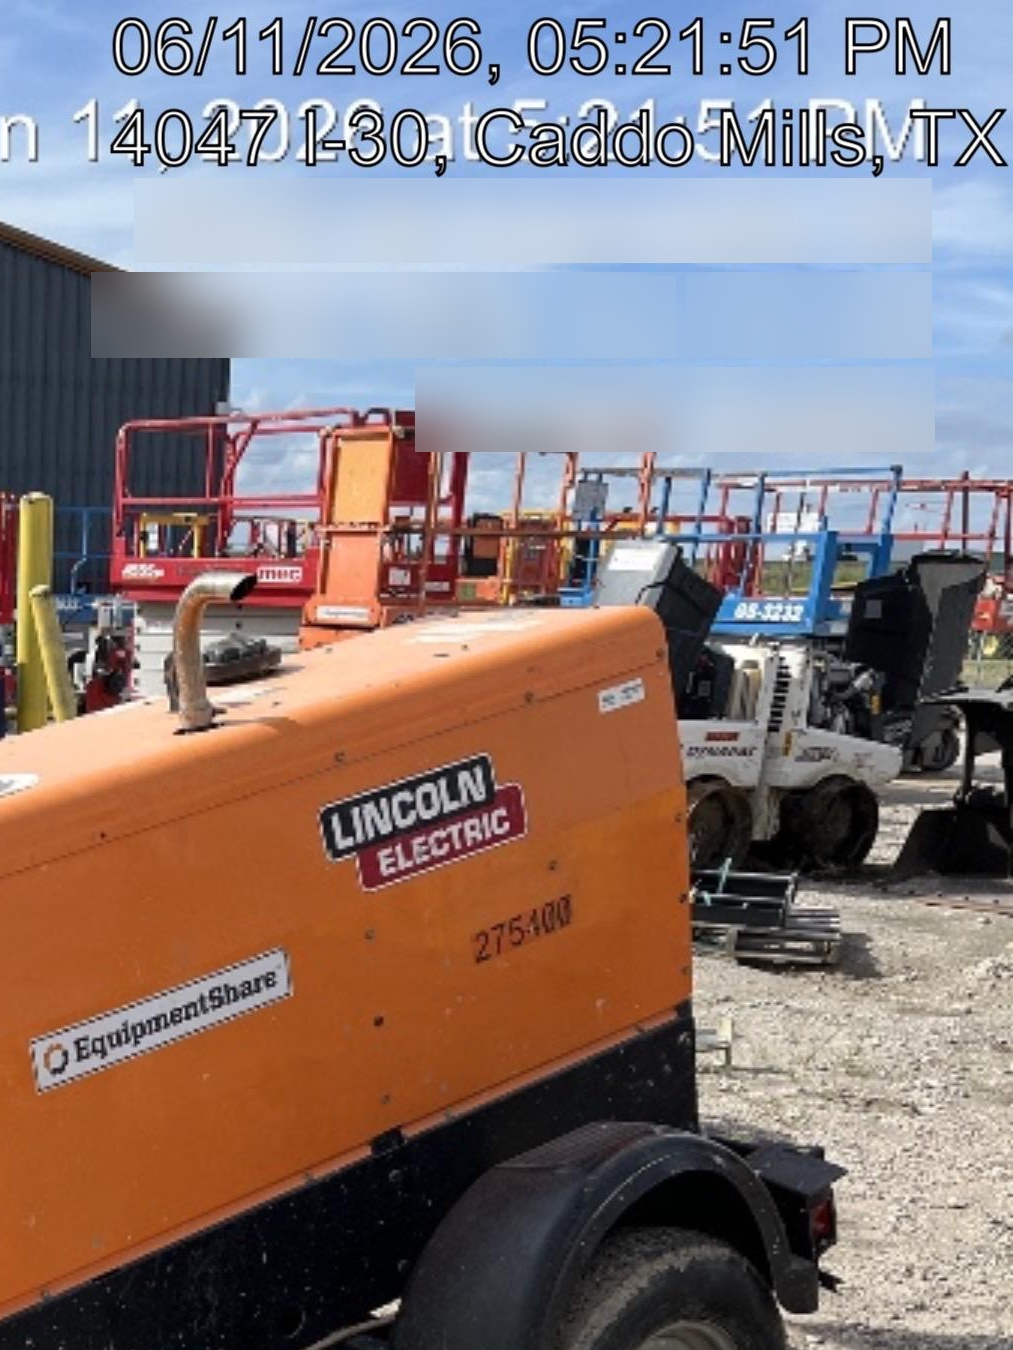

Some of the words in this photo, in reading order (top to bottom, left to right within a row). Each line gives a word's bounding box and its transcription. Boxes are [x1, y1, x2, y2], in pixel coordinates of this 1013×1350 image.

[331, 765, 487, 850] LINCOLN
[377, 806, 510, 877] ELECTRIC
[74, 970, 278, 1063] EquipmentShare
